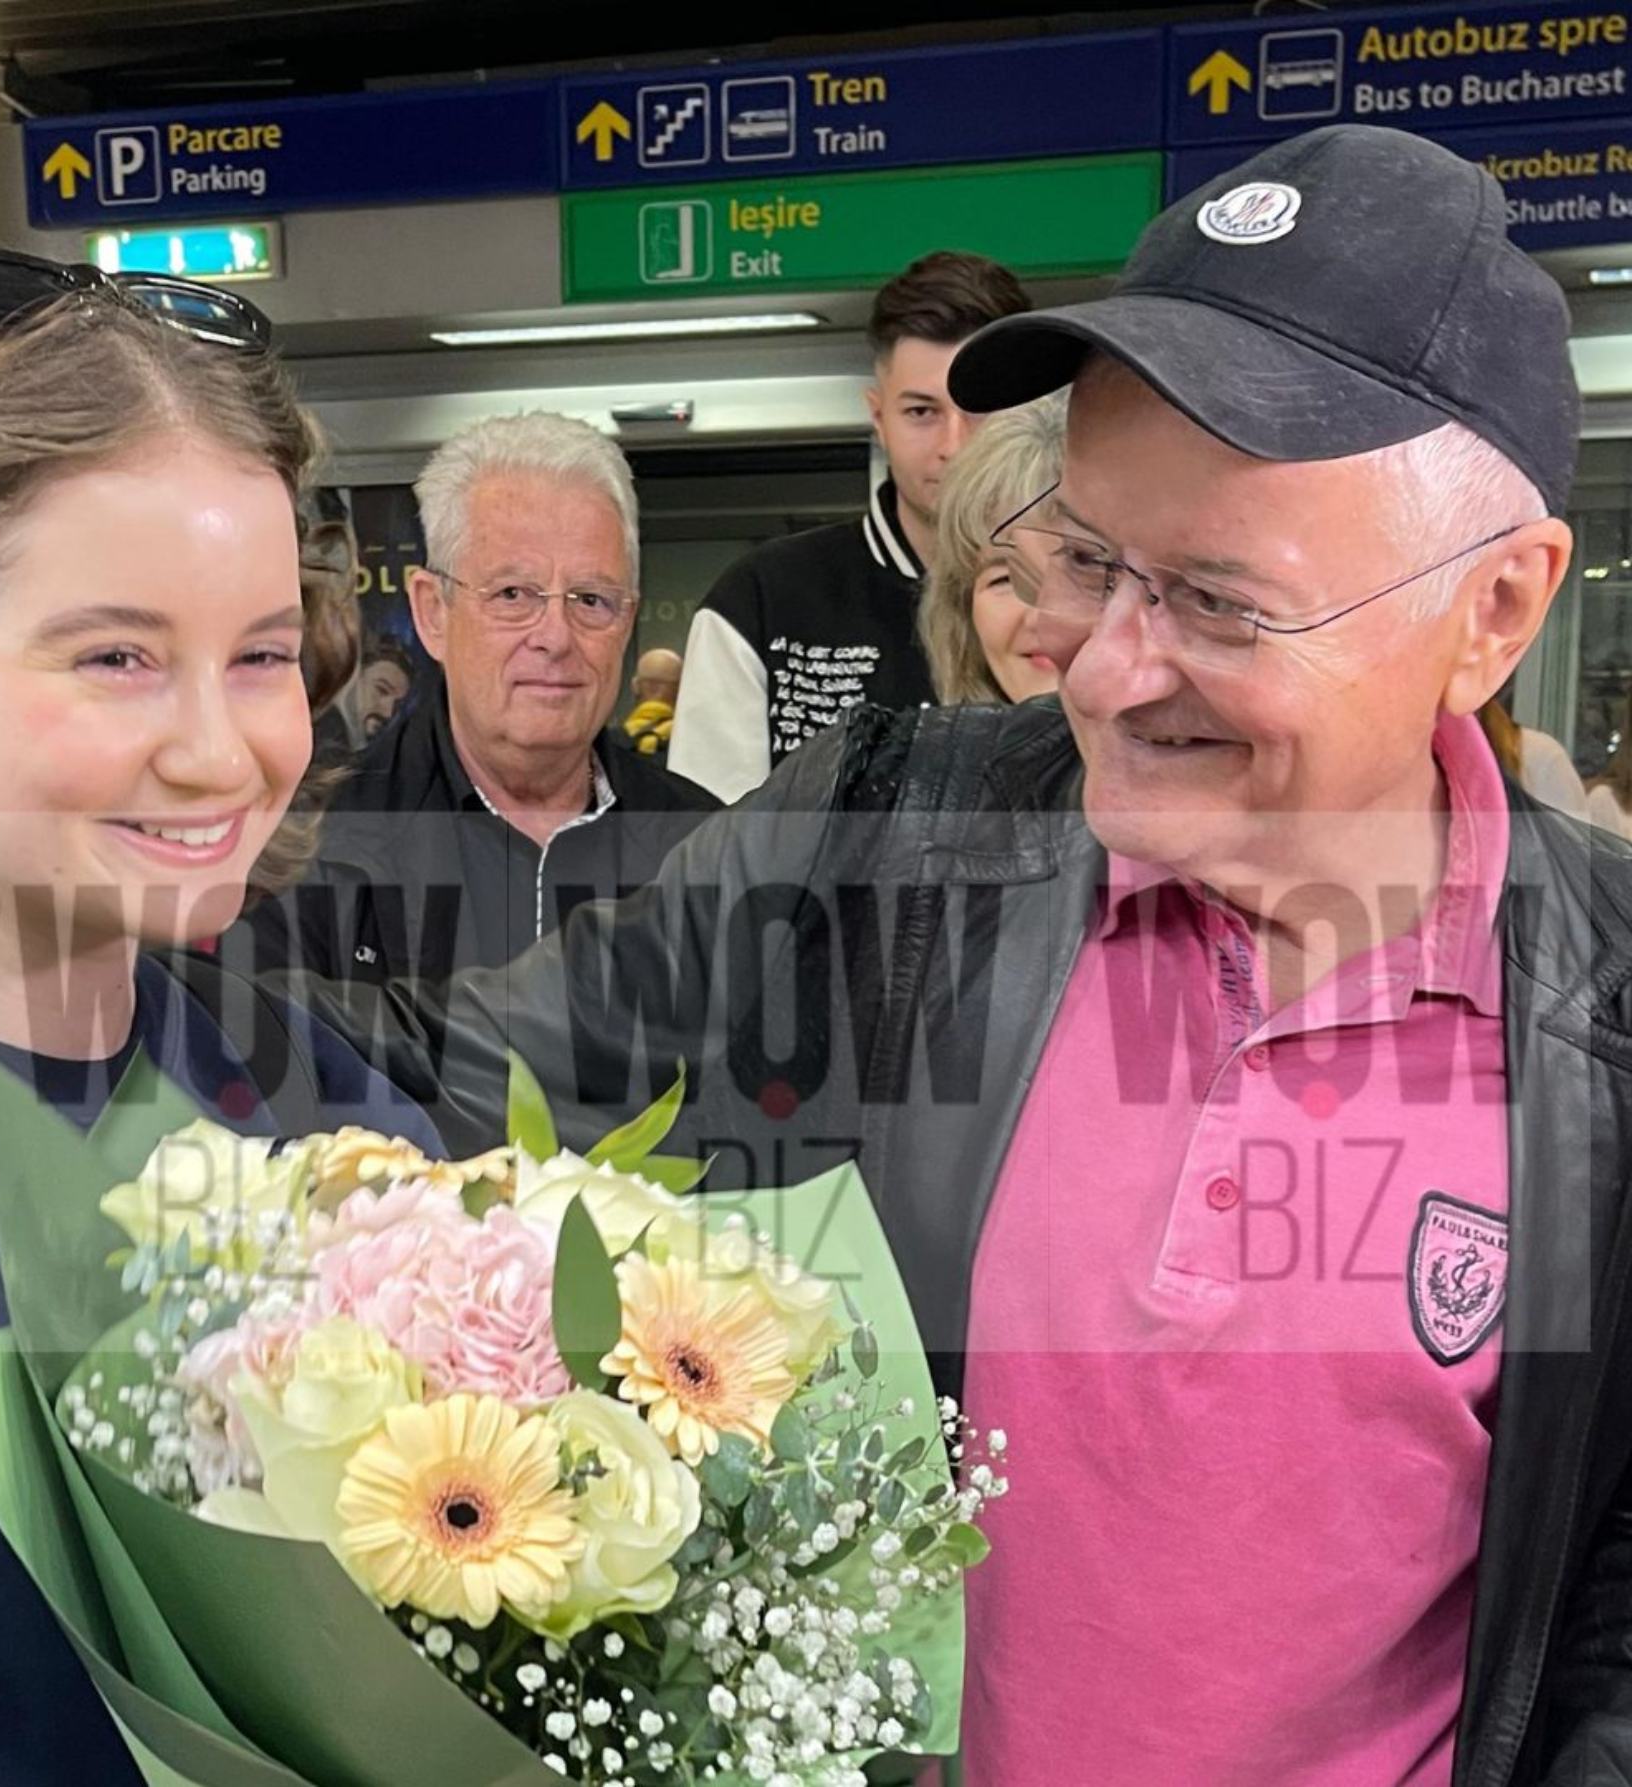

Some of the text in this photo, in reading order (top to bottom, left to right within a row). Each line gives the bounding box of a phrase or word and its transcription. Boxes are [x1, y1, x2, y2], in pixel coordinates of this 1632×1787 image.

[1357, 14, 1627, 62] Autobuz spre
[808, 70, 887, 107] Tren
[1354, 66, 1626, 113] Bus to Bucharest
[813, 124, 886, 155] Train
[110, 124, 282, 196] P Parcare
[1479, 149, 1599, 181] icrobuz
[171, 164, 266, 196] Parking
[1505, 193, 1602, 225] Shuttle
[731, 249, 783, 279] Exit
